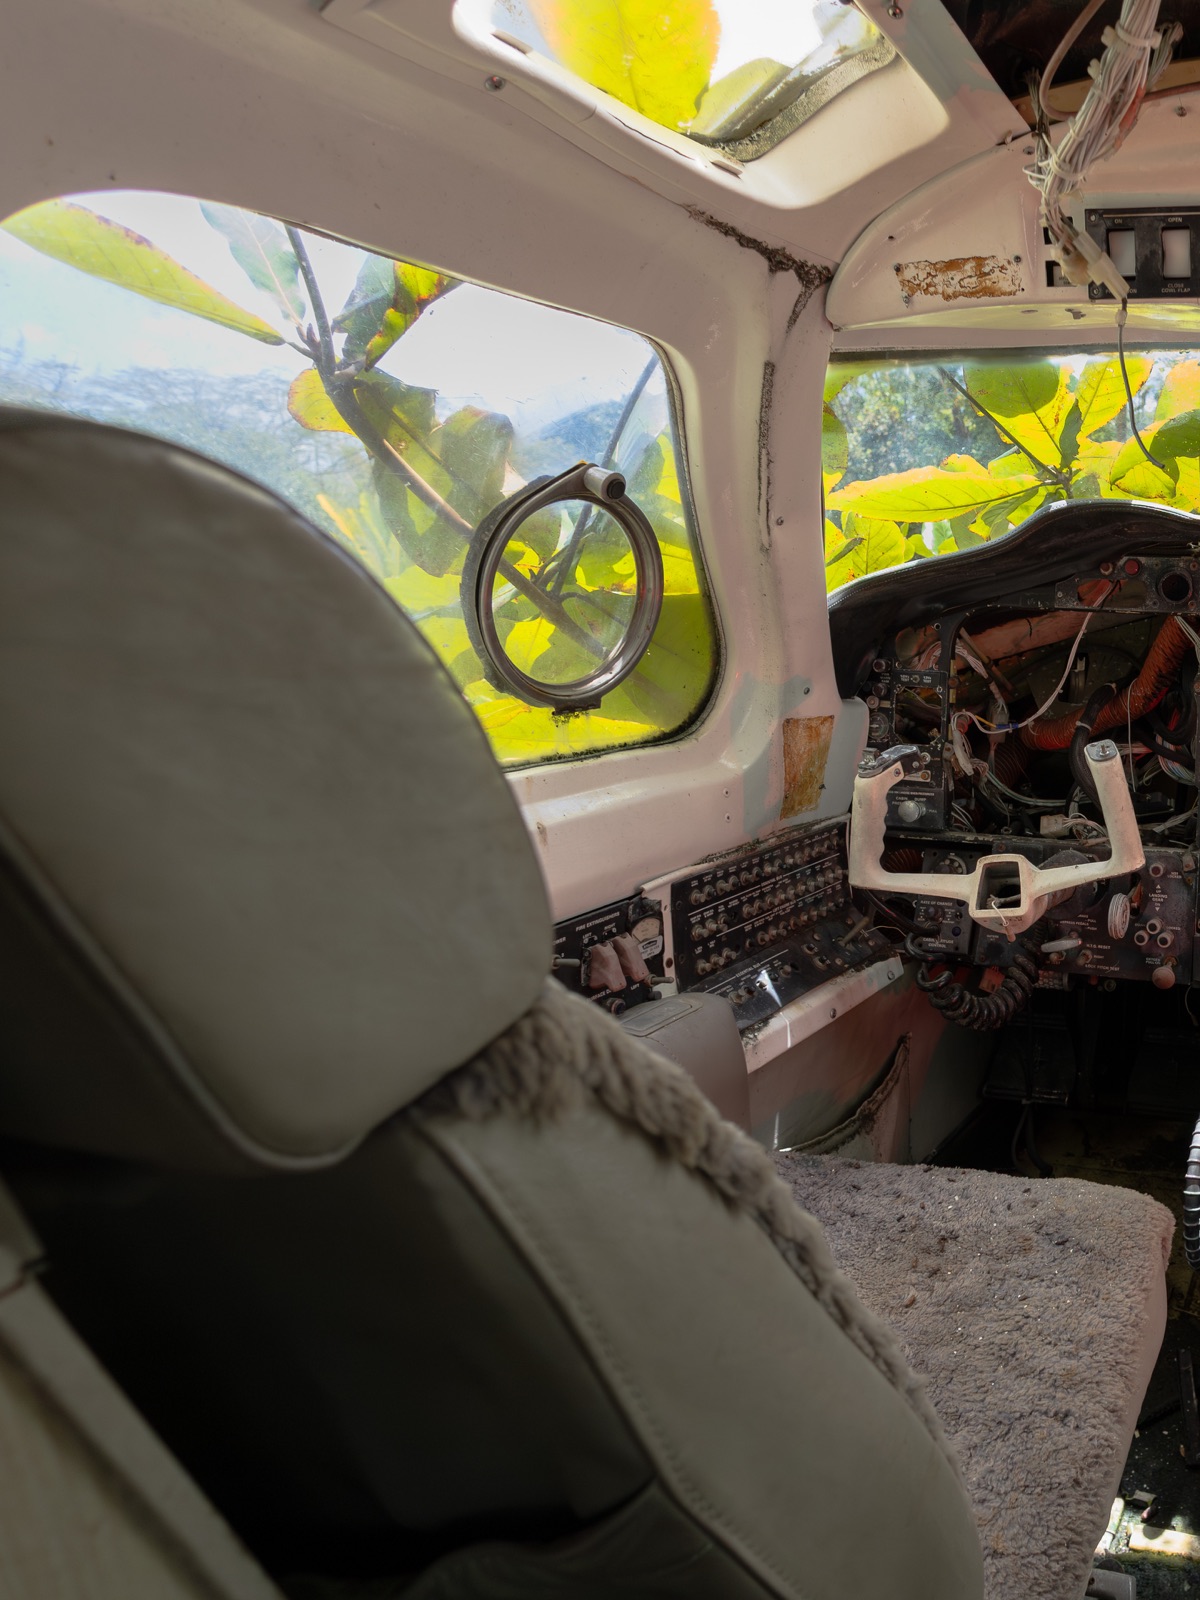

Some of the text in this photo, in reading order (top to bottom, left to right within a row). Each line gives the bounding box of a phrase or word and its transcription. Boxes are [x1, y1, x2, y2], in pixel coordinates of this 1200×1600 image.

[575, 911, 620, 932] FIRE EXTINGUISHERS
[736, 966, 754, 978] ESSENTIAL
[588, 990, 607, 1001] URFACE
